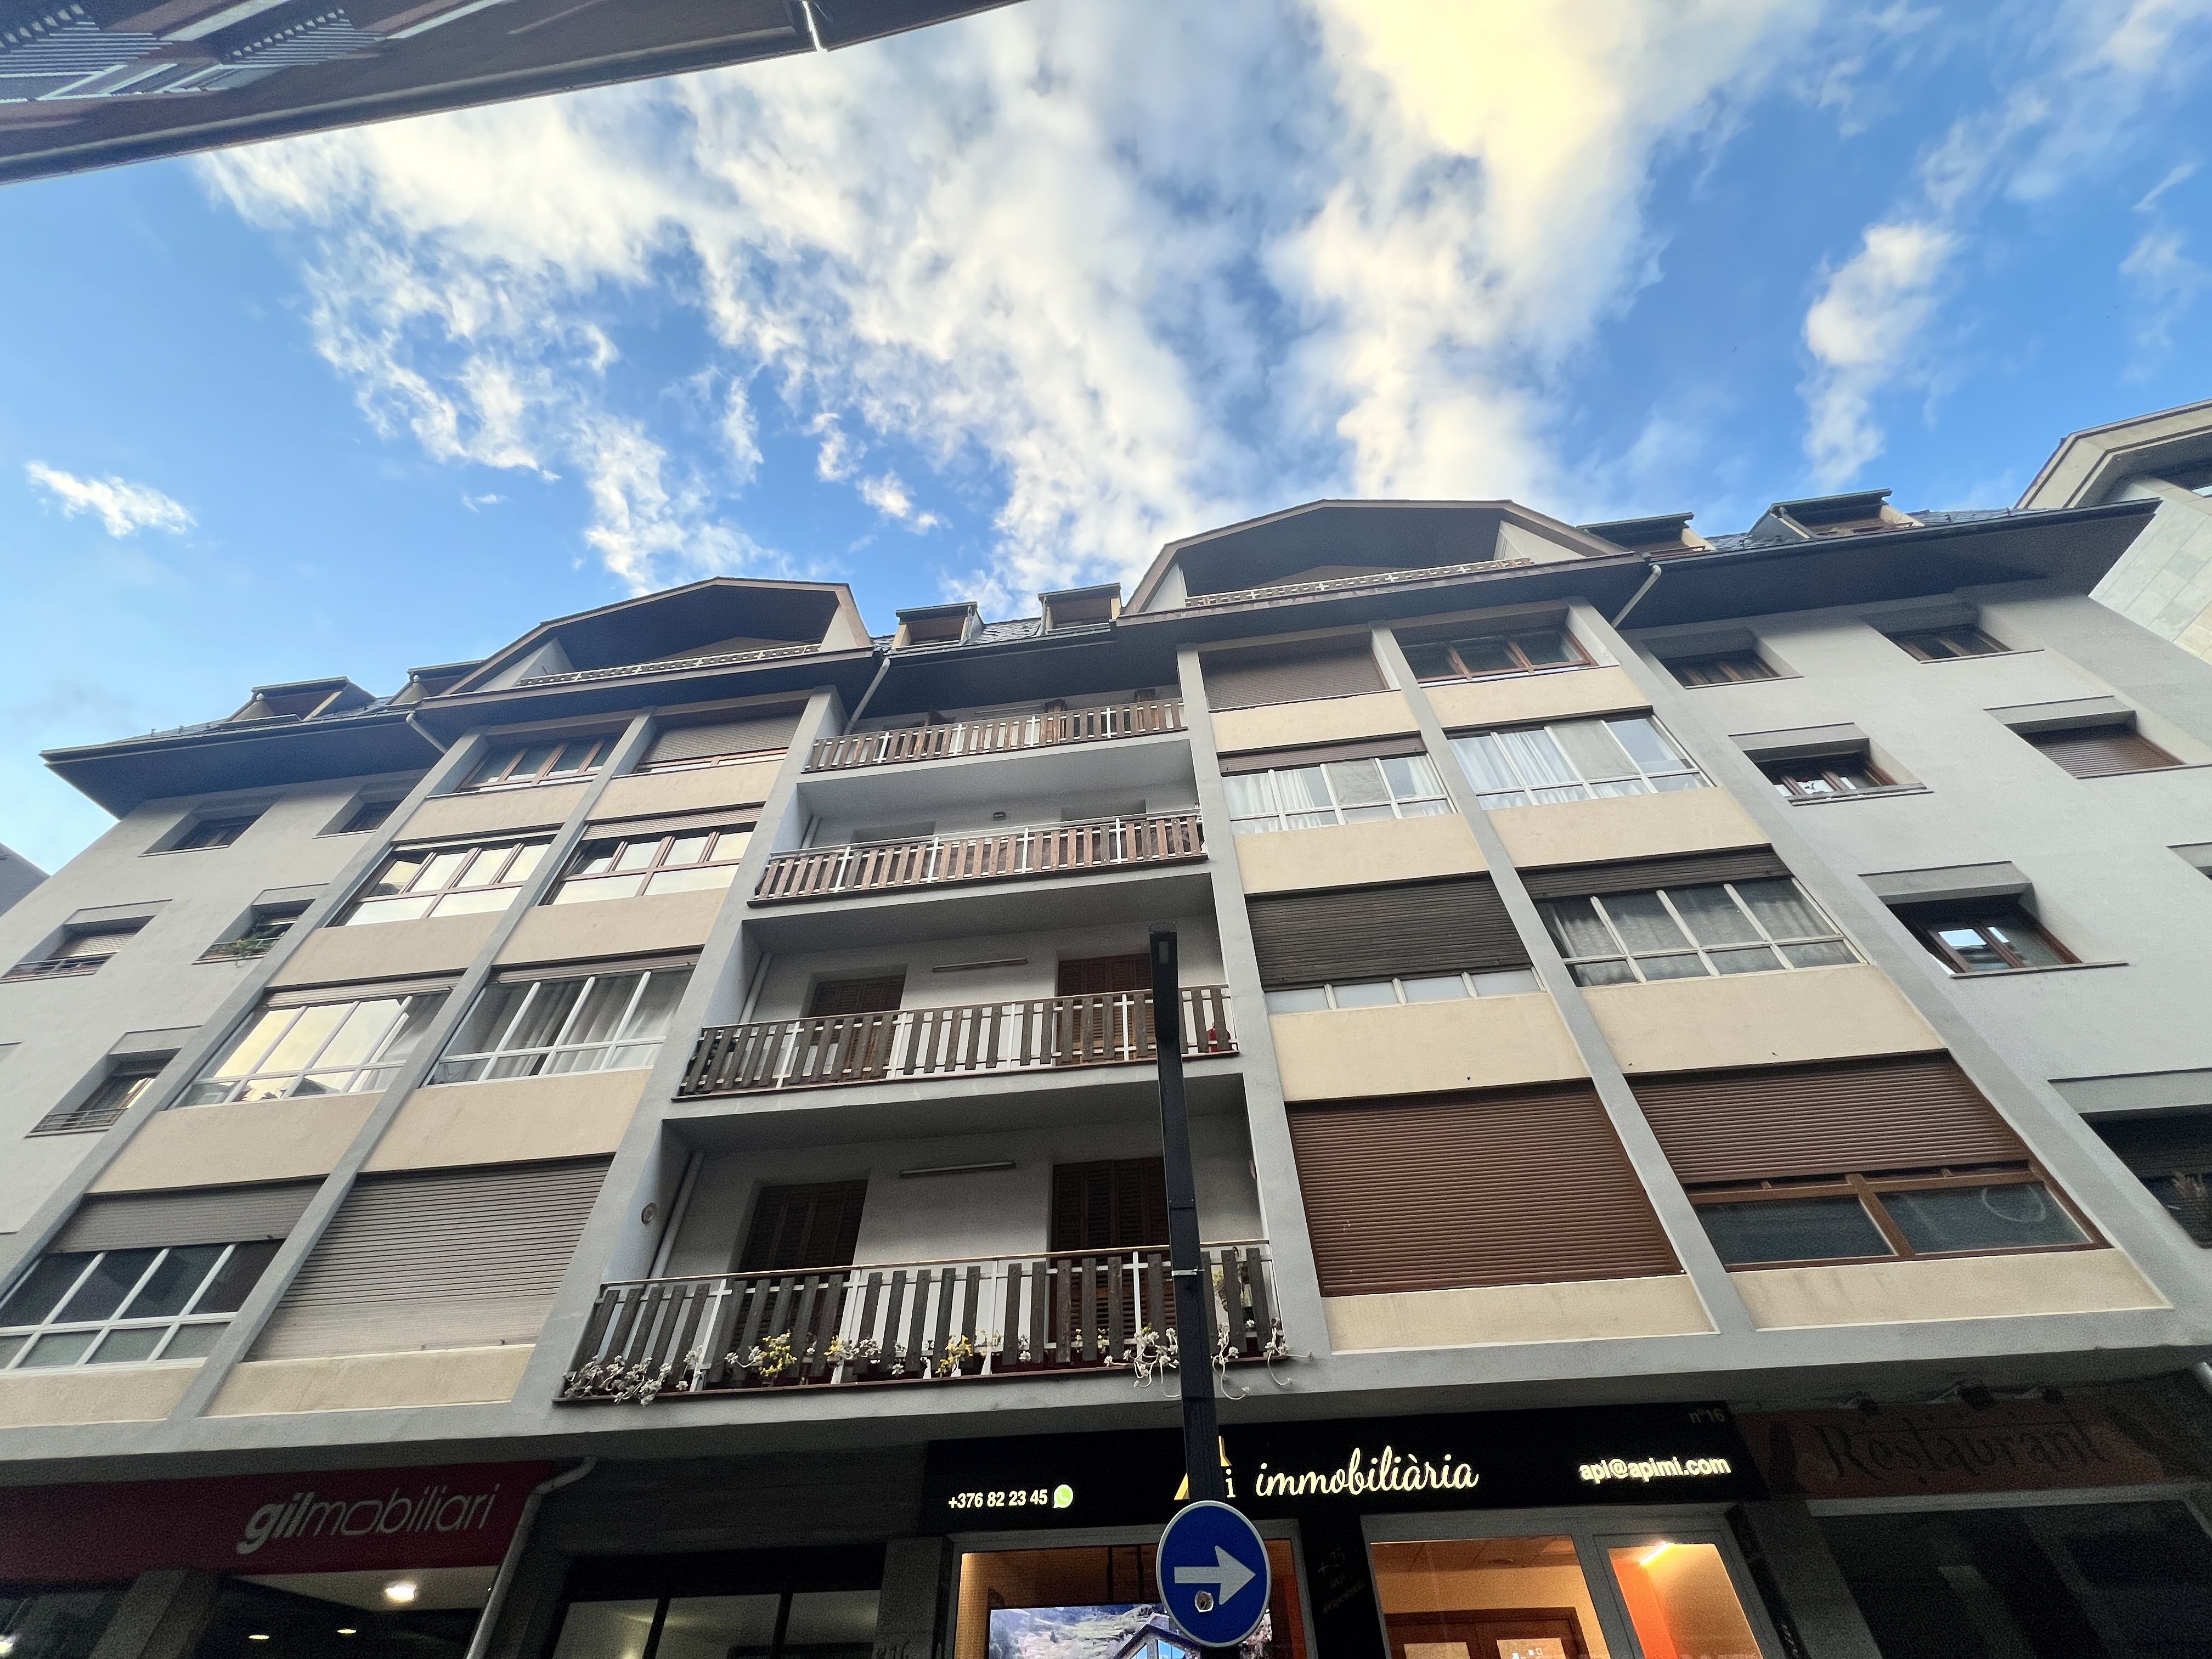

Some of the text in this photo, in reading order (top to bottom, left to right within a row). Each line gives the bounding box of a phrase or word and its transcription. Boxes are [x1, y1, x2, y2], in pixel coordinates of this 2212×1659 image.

[1255, 1444, 1480, 1497] immobiliària
[1579, 1455, 1732, 1485] api@apimi.com
[236, 1483, 501, 1555] gilmobiliari
[948, 1488, 1048, 1509] +376 82 23 45
